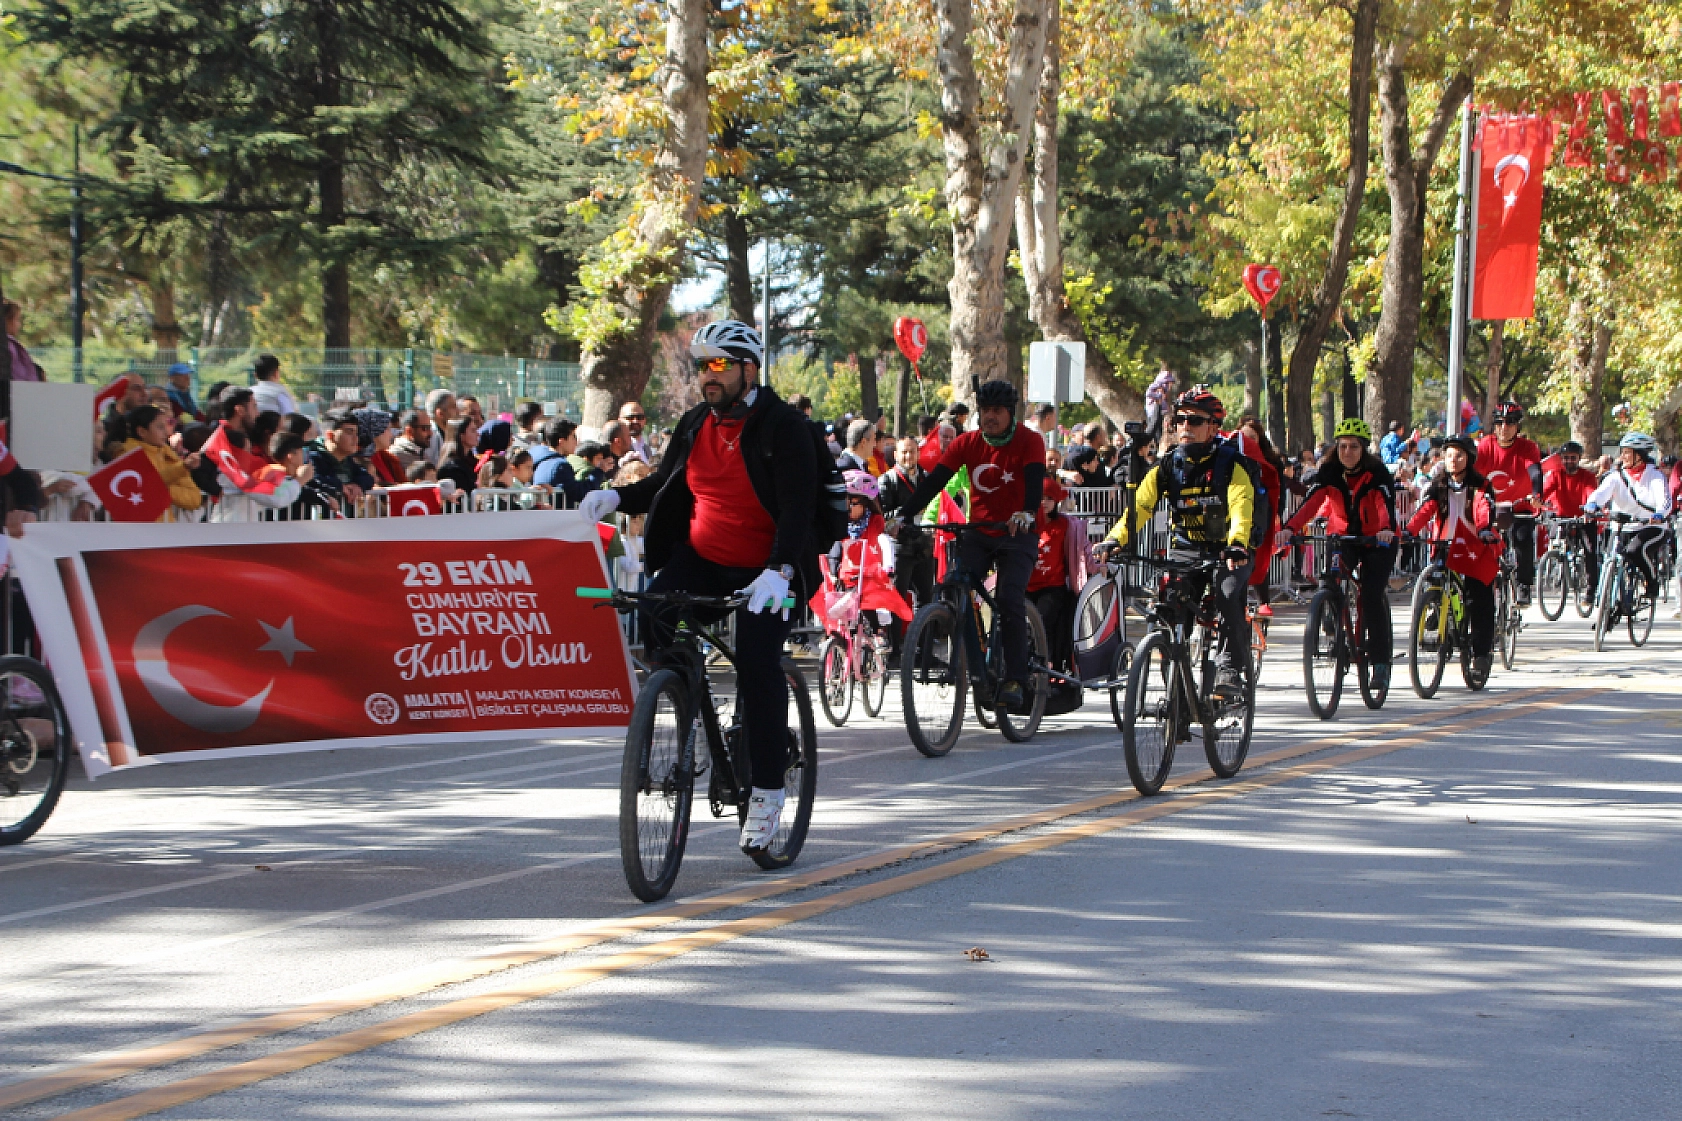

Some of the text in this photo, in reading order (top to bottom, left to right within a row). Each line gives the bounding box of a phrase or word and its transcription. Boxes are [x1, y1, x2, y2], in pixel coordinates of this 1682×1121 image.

[397, 553, 532, 586] 29 EKİM
[406, 588, 538, 609] CUMHURİYET
[412, 612, 552, 637] BAYRAMI
[394, 634, 592, 681] Kutlu Olsun
[404, 692, 466, 708] MALATYA
[475, 687, 621, 701] MALATYA KENT KONSEYİ
[408, 709, 432, 720] KENT
[475, 703, 629, 717] BİSİKLET ÇALIŞMA GRUBU
